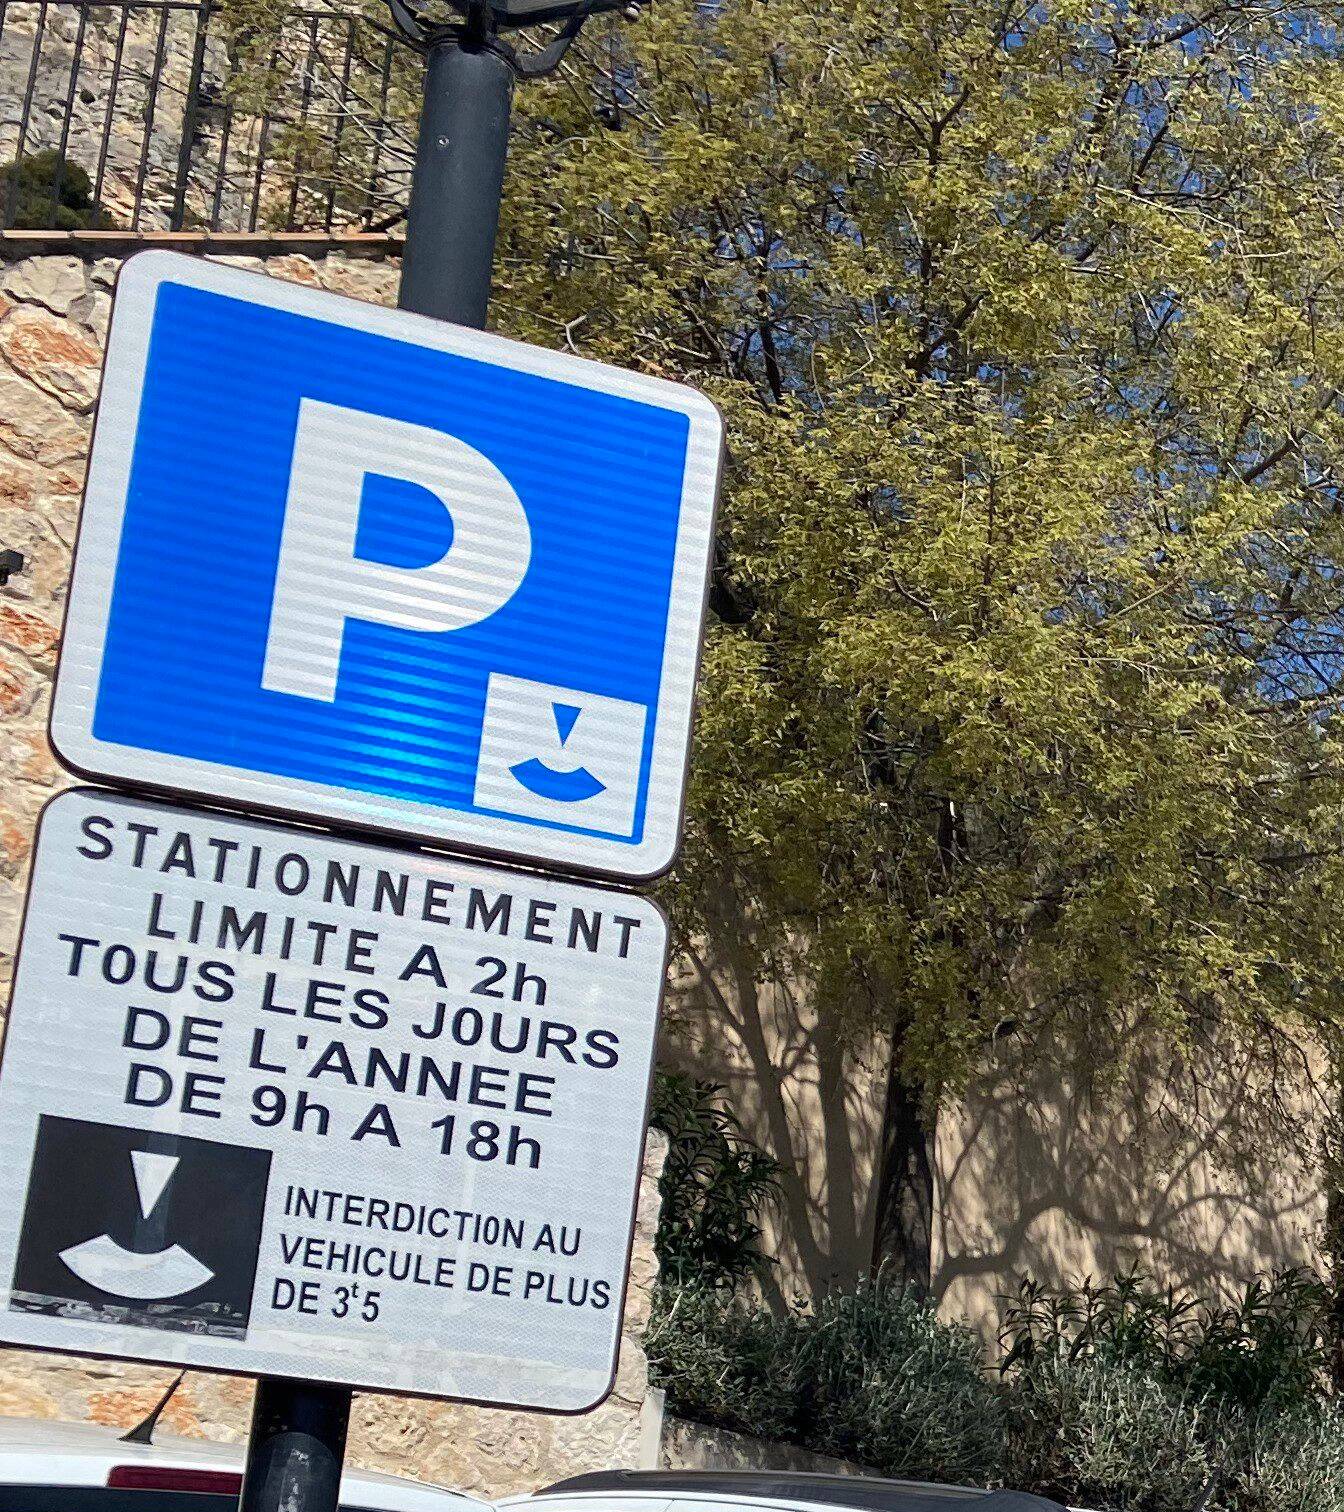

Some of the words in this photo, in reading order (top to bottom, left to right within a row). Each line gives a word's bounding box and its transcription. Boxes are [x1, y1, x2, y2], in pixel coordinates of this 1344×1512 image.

[261, 397, 532, 703] P
[74, 814, 643, 960] STATIONNEMENT
[56, 932, 237, 1004] TOUS
[260, 970, 391, 1031] LES
[410, 1000, 621, 1070] JOURS
[145, 891, 380, 977] LIMITE
[396, 942, 449, 990] A
[468, 955, 548, 1008] 2h
[120, 1004, 225, 1064] DE
[247, 1026, 557, 1119] L'ANNEE
[122, 1060, 227, 1121] DE
[248, 1083, 331, 1138] 9h
[349, 1101, 403, 1149] A
[429, 1113, 542, 1171] 18h
[278, 1232, 458, 1290] VEHICULE
[466, 1261, 515, 1298] DE
[522, 1268, 612, 1311] PLUS
[283, 1184, 526, 1251] INTERDICTION
[530, 1222, 583, 1258] AU
[269, 1276, 322, 1317] DE
